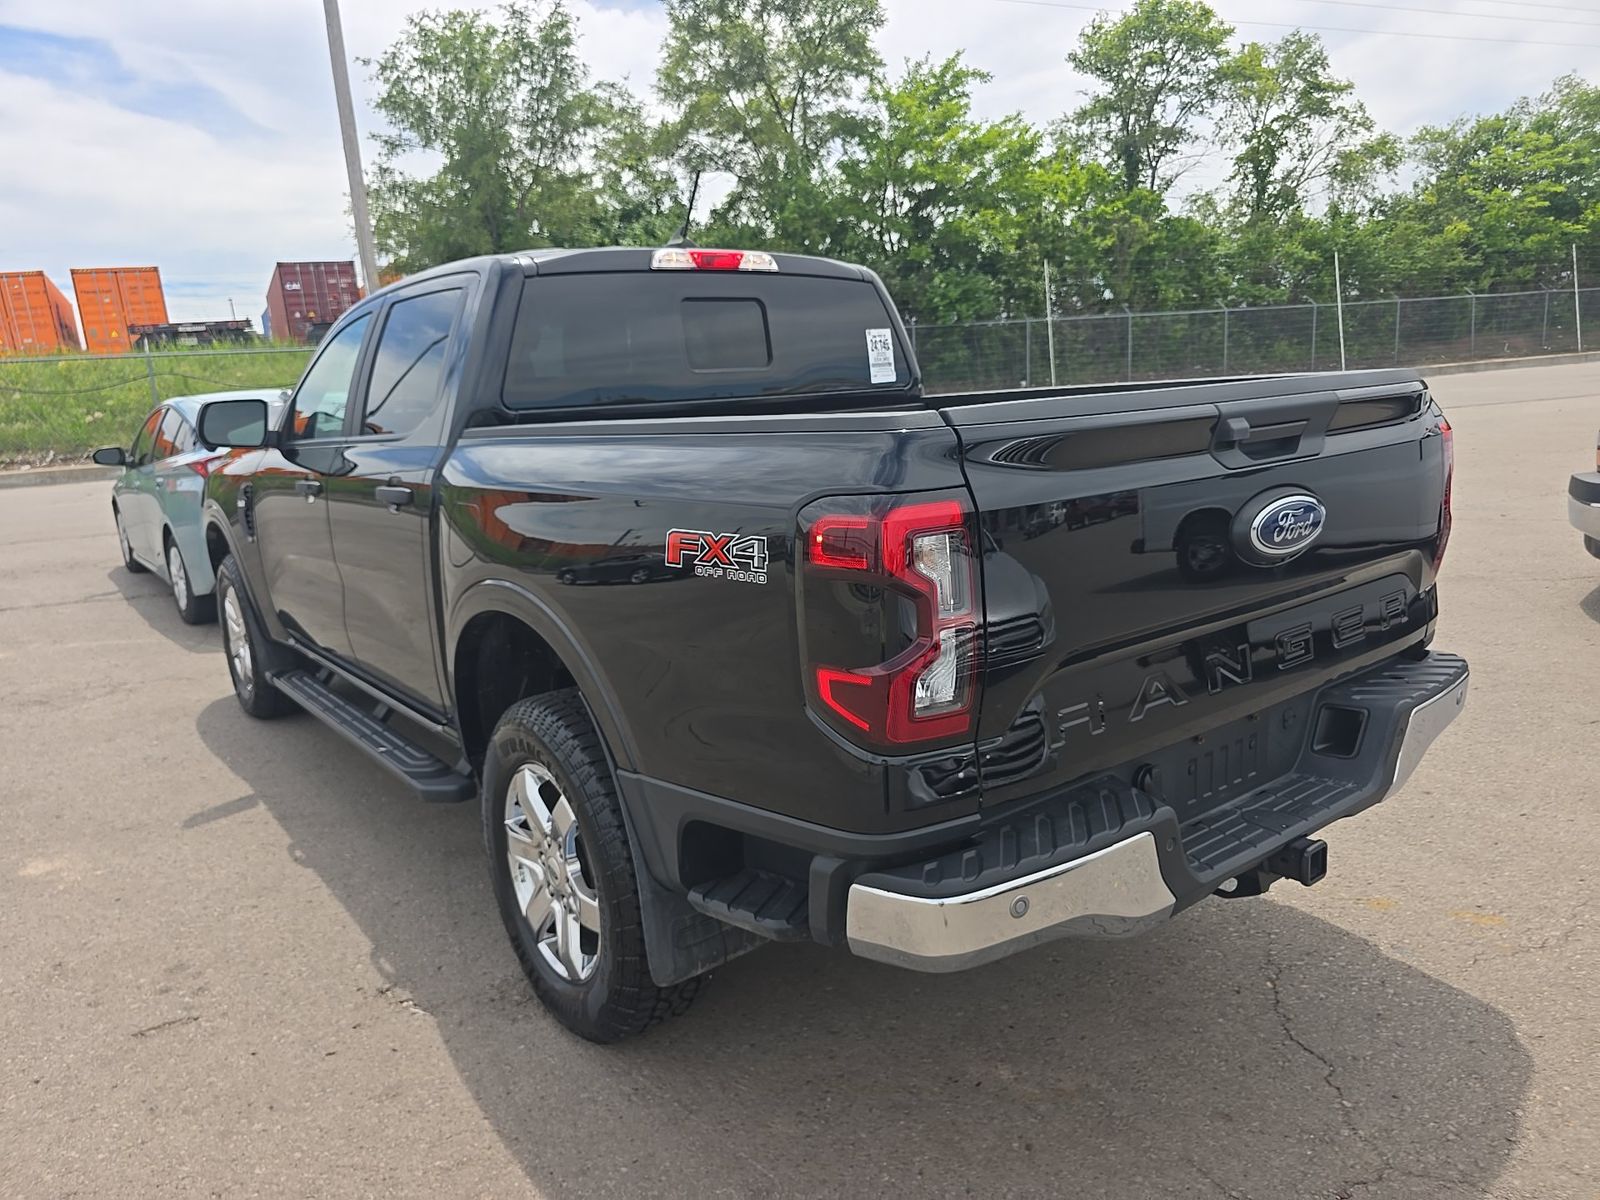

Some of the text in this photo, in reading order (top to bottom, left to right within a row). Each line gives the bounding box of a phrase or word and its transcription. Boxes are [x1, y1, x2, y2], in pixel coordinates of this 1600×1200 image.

[1273, 507, 1315, 543] Ford
[665, 528, 768, 572] FX4
[694, 565, 767, 584] OFF ROAD
[1050, 590, 1409, 749] RANGER
